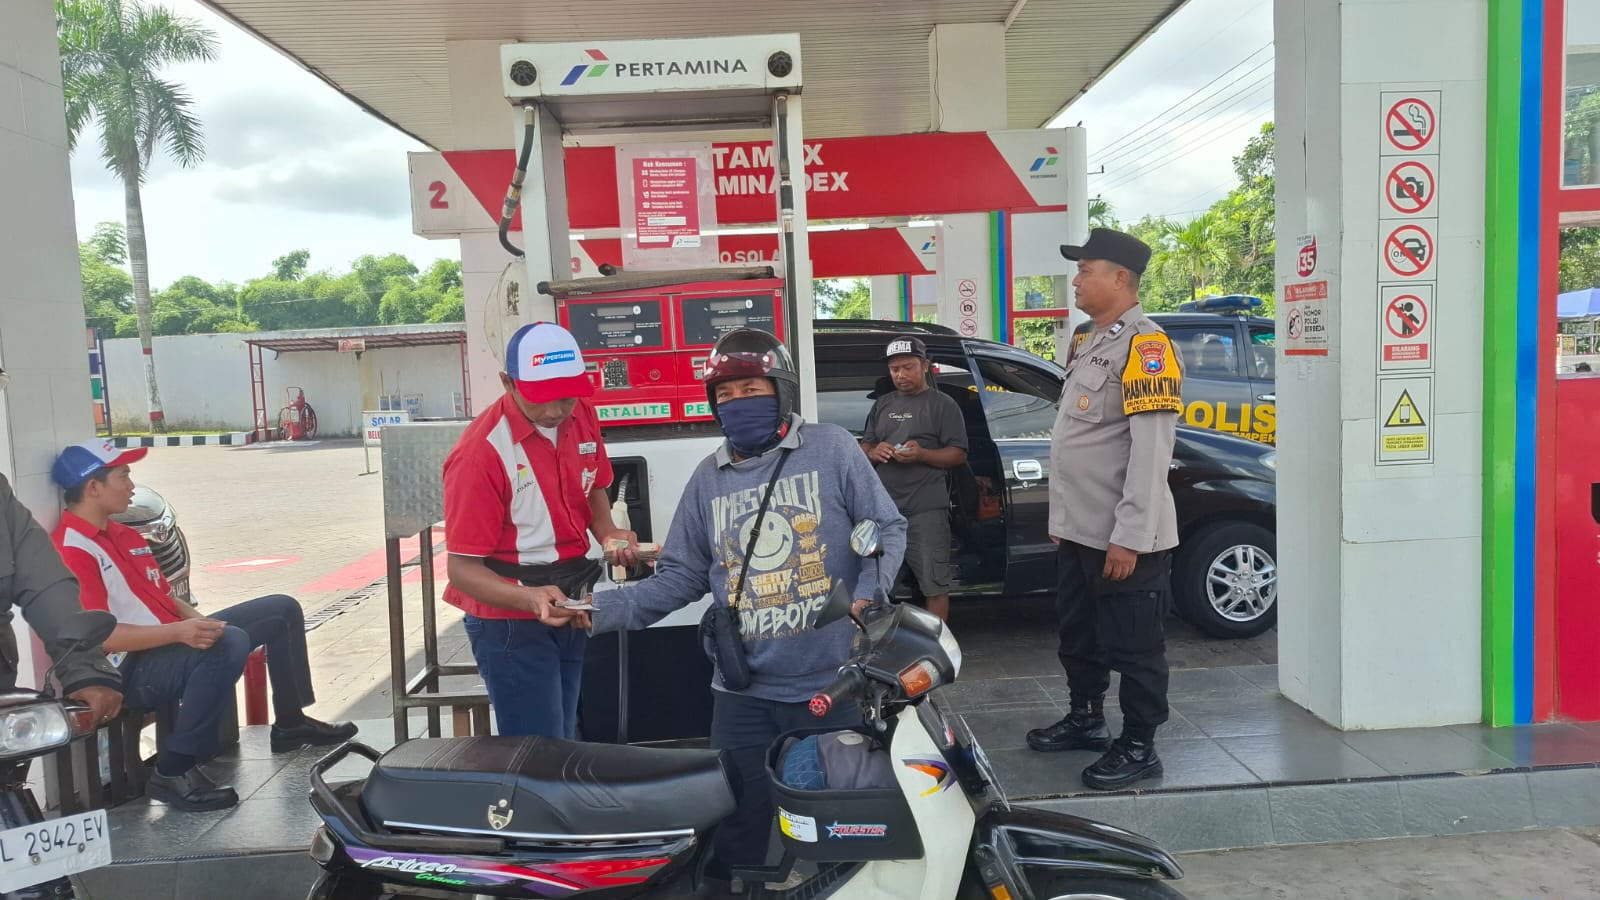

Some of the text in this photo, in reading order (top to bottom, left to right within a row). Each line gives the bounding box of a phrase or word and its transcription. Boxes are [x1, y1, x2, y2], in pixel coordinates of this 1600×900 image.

[615, 58, 748, 77] PERTAMINA
[428, 180, 449, 209] 2
[600, 404, 671, 418] RTALITE
[0, 815, 103, 862] L 2942 EV
[361, 856, 457, 873] Astrea
